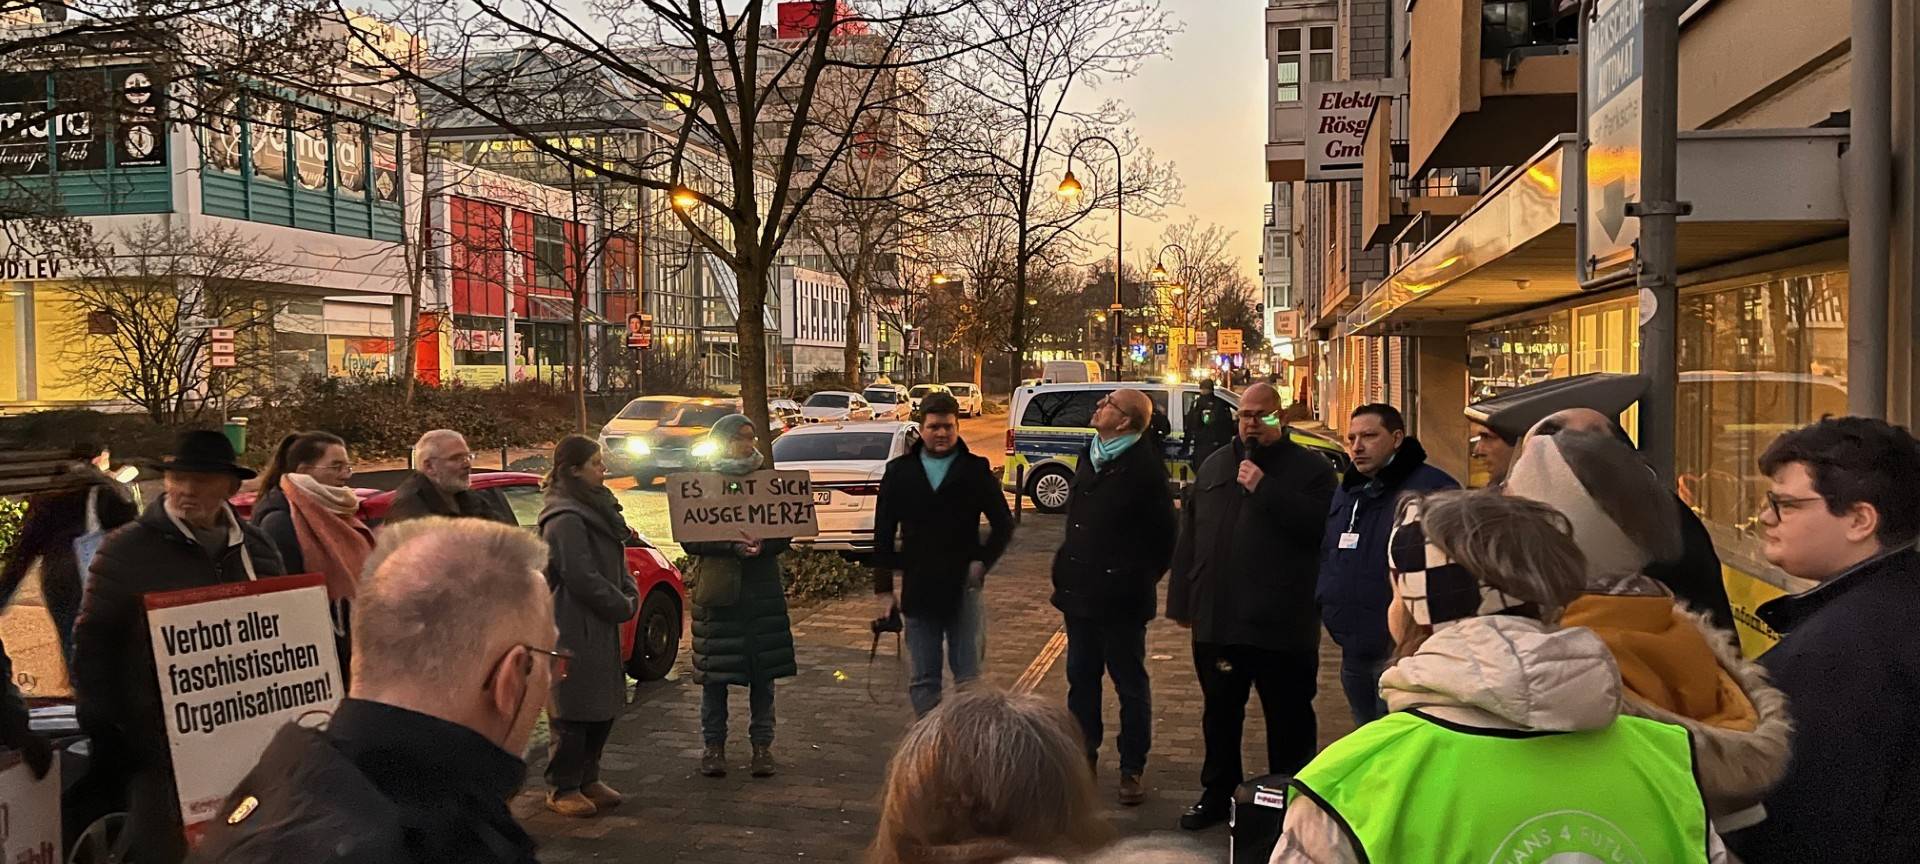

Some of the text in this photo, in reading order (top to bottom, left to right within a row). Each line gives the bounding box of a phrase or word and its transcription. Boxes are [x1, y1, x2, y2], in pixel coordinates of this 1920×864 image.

[1597, 36, 1634, 104] AUTOMAT
[1318, 115, 1367, 138] Rösg
[681, 479, 811, 499] ES HAT SICH
[161, 611, 280, 657] Verbot aller
[168, 643, 320, 696] faschistischen
[174, 672, 333, 734] Organisationen!
[1507, 828, 1552, 864] ANS
[1560, 825, 1571, 840] 4
